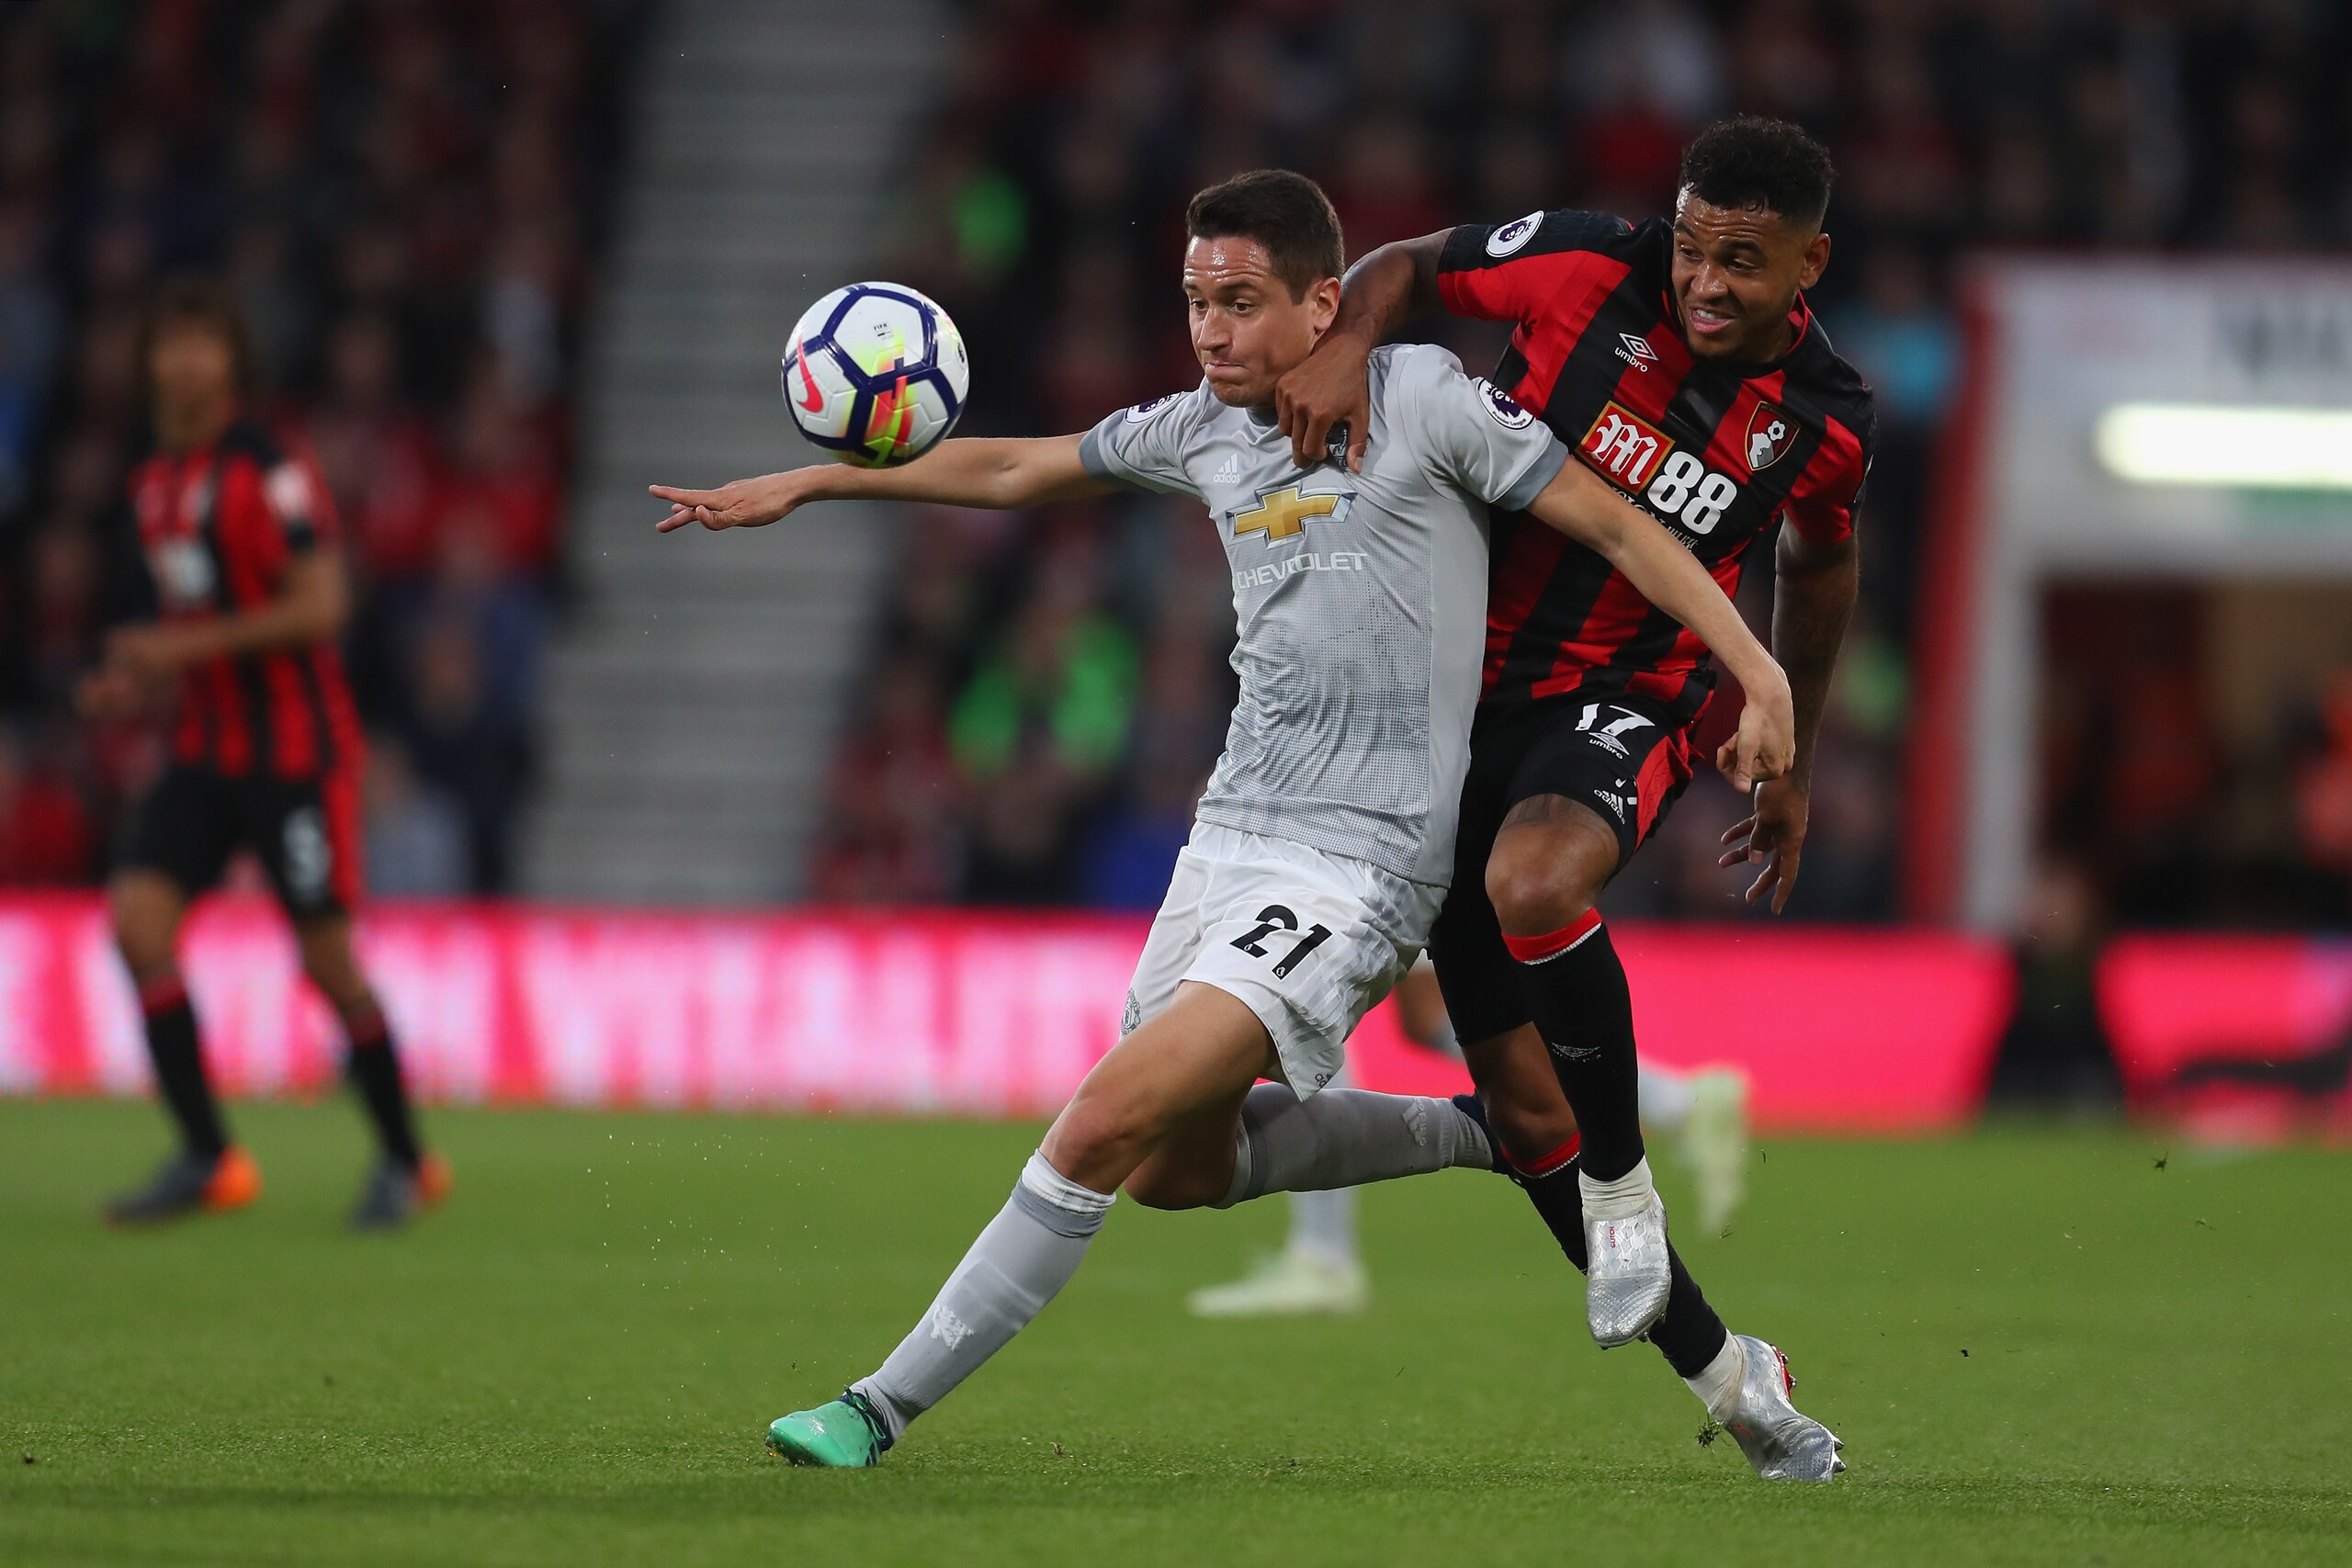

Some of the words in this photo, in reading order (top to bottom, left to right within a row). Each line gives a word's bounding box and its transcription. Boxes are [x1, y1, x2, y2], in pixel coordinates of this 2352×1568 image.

[1614, 347, 1648, 372] umbro
[1213, 471, 1240, 484] adidas
[1575, 703, 1656, 737] 17
[1589, 739, 1623, 760] umbro
[1228, 904, 1333, 981] 21
